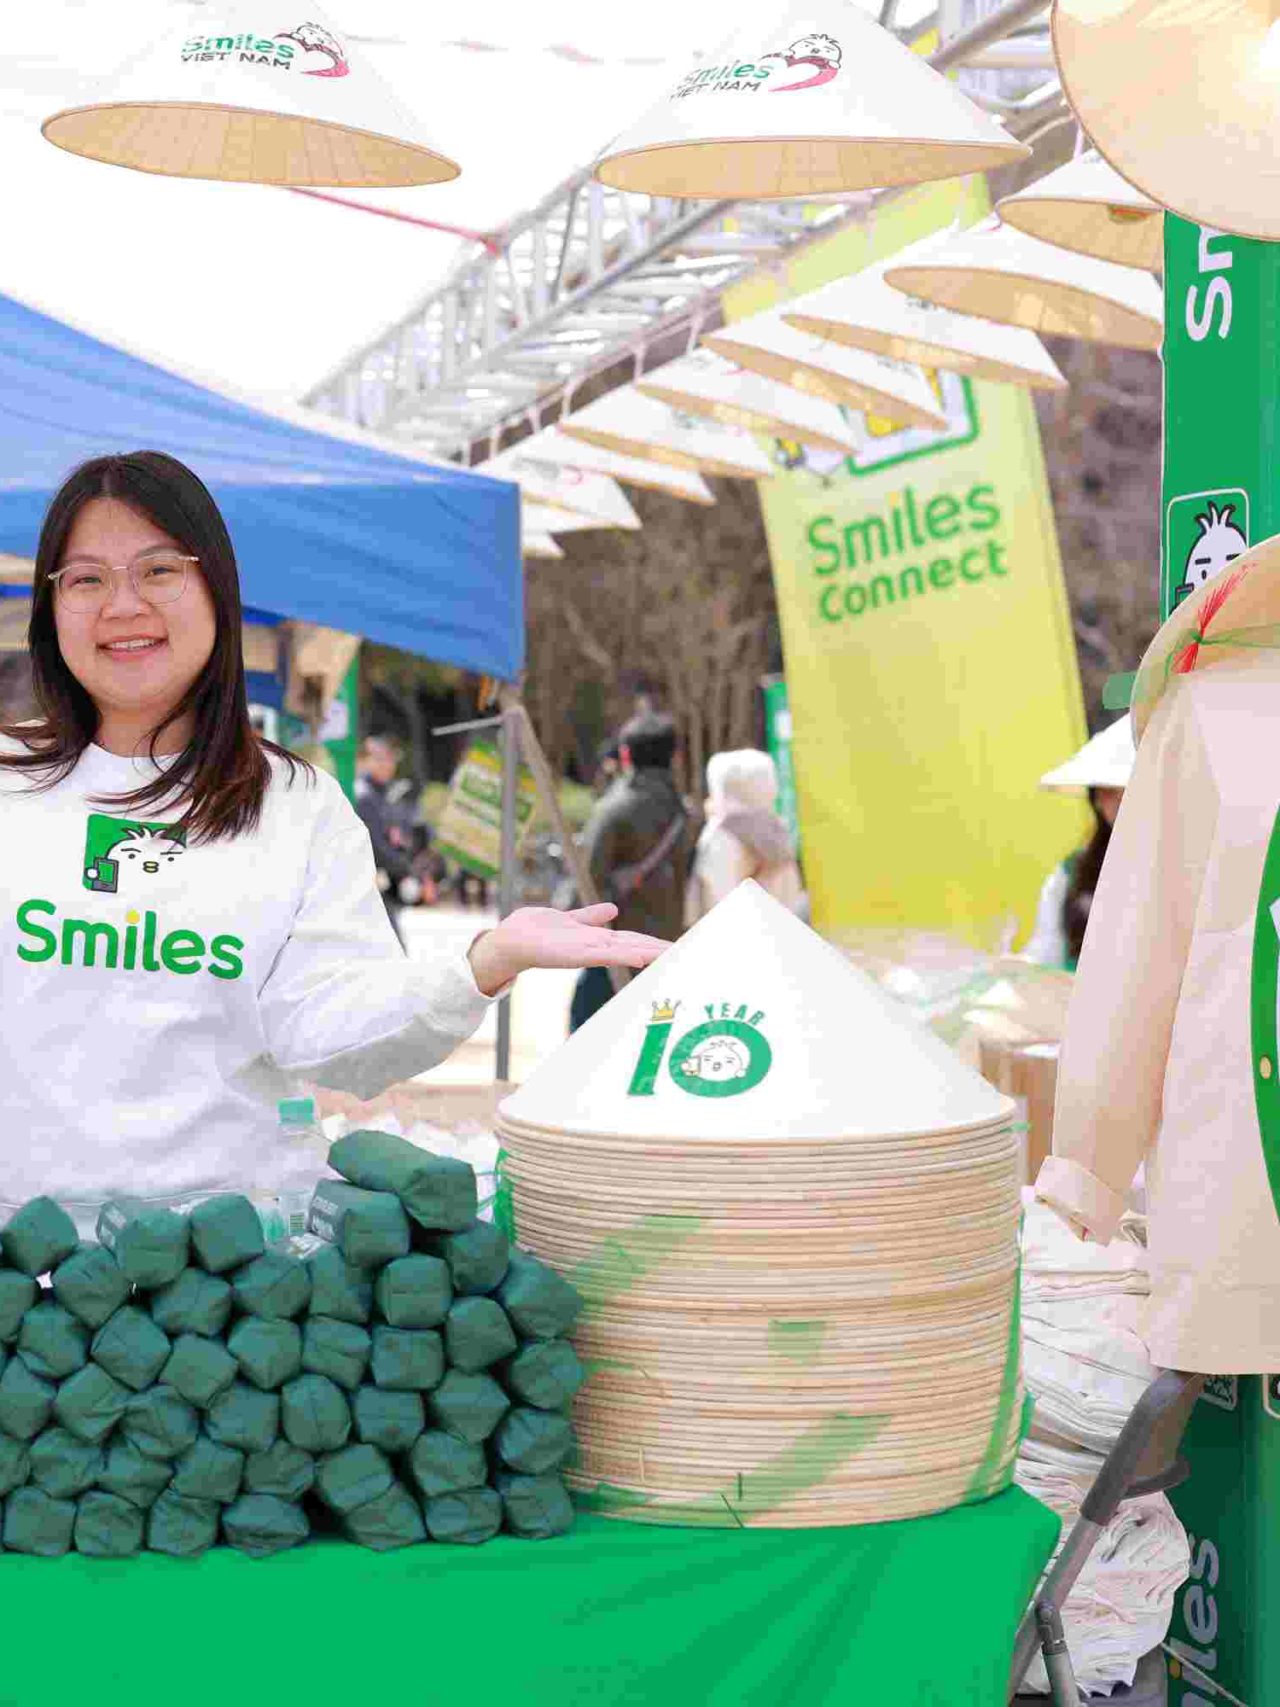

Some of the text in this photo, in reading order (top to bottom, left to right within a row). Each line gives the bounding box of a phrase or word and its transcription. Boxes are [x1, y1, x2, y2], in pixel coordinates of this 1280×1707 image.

[181, 34, 294, 59] Smiles
[181, 51, 291, 70] VIET NAM
[713, 80, 762, 92] NAM
[808, 485, 1000, 576] Smiles
[17, 899, 245, 980] Smiles
[705, 1002, 764, 1025] YEAR
[628, 1019, 772, 1098] 10
